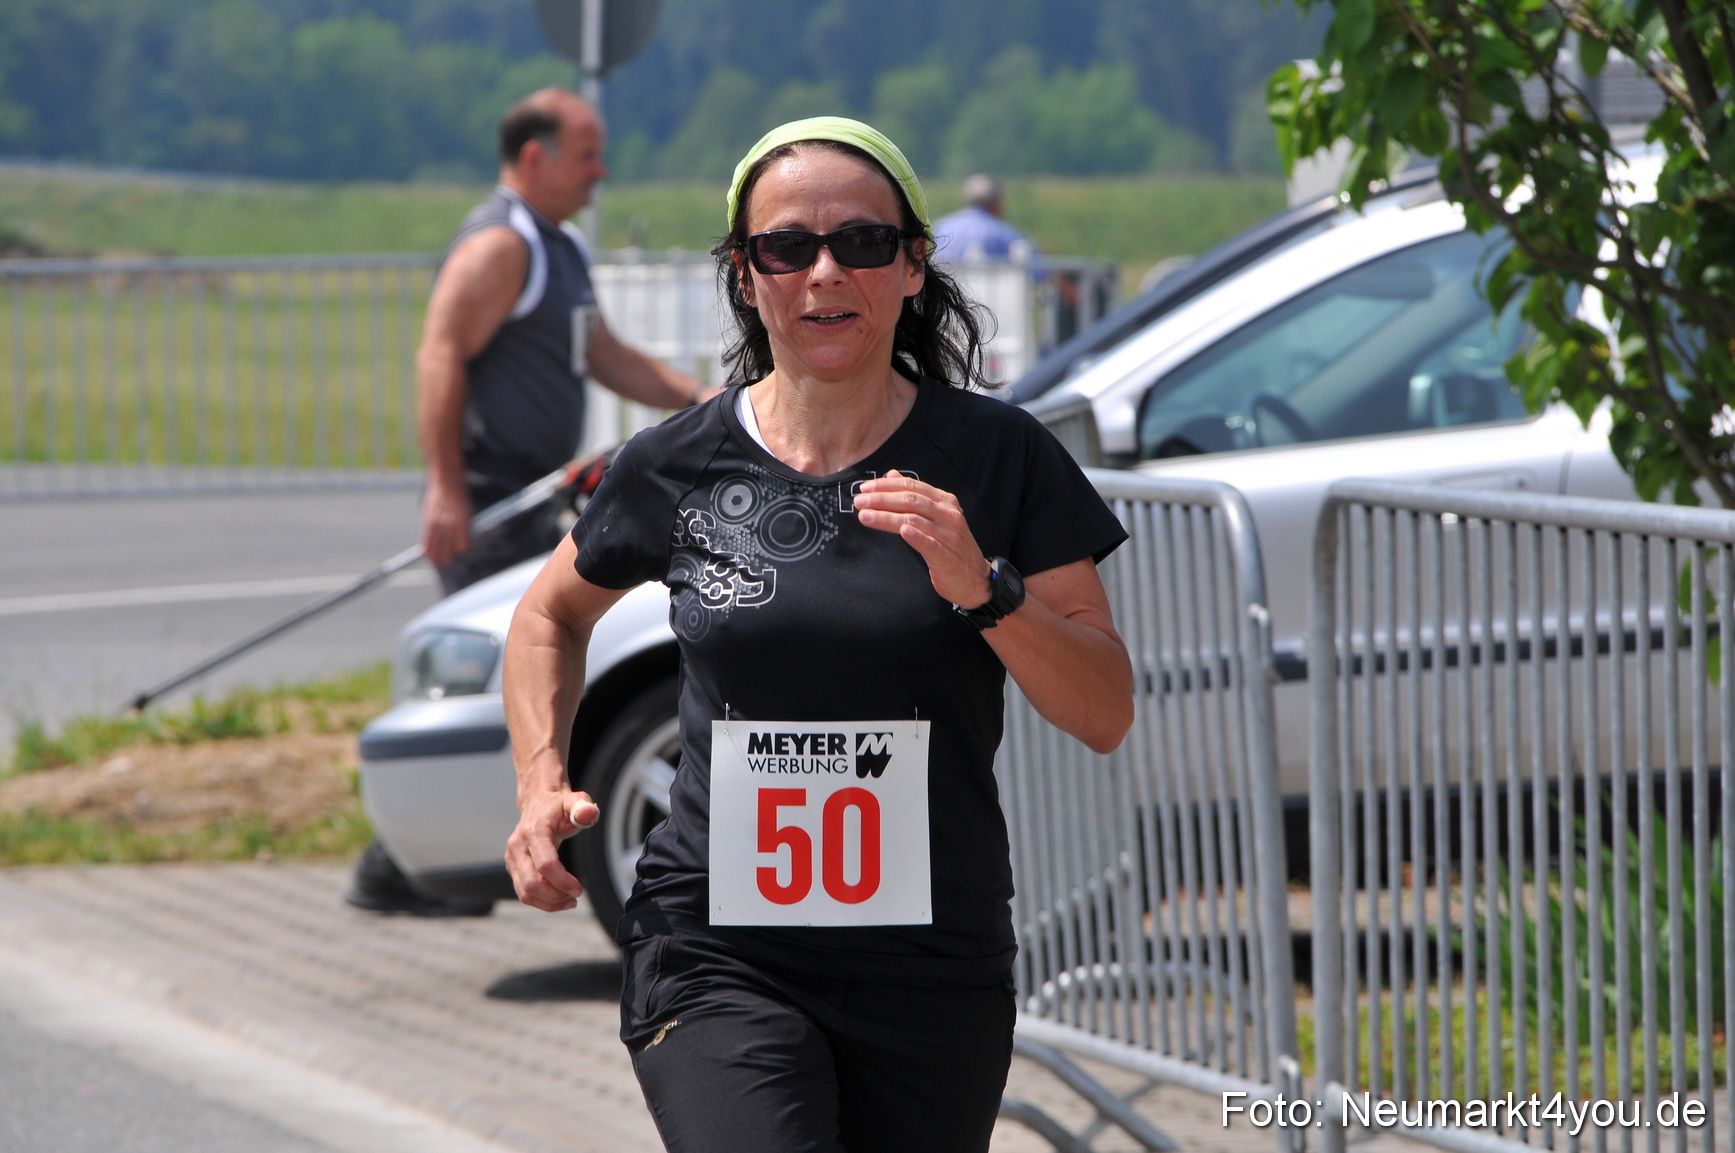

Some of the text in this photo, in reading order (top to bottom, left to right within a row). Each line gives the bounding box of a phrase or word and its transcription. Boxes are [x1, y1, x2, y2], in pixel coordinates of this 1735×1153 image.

[748, 732, 848, 755] MEYER
[747, 757, 849, 774] WERBUNG
[756, 787, 881, 905] 50
